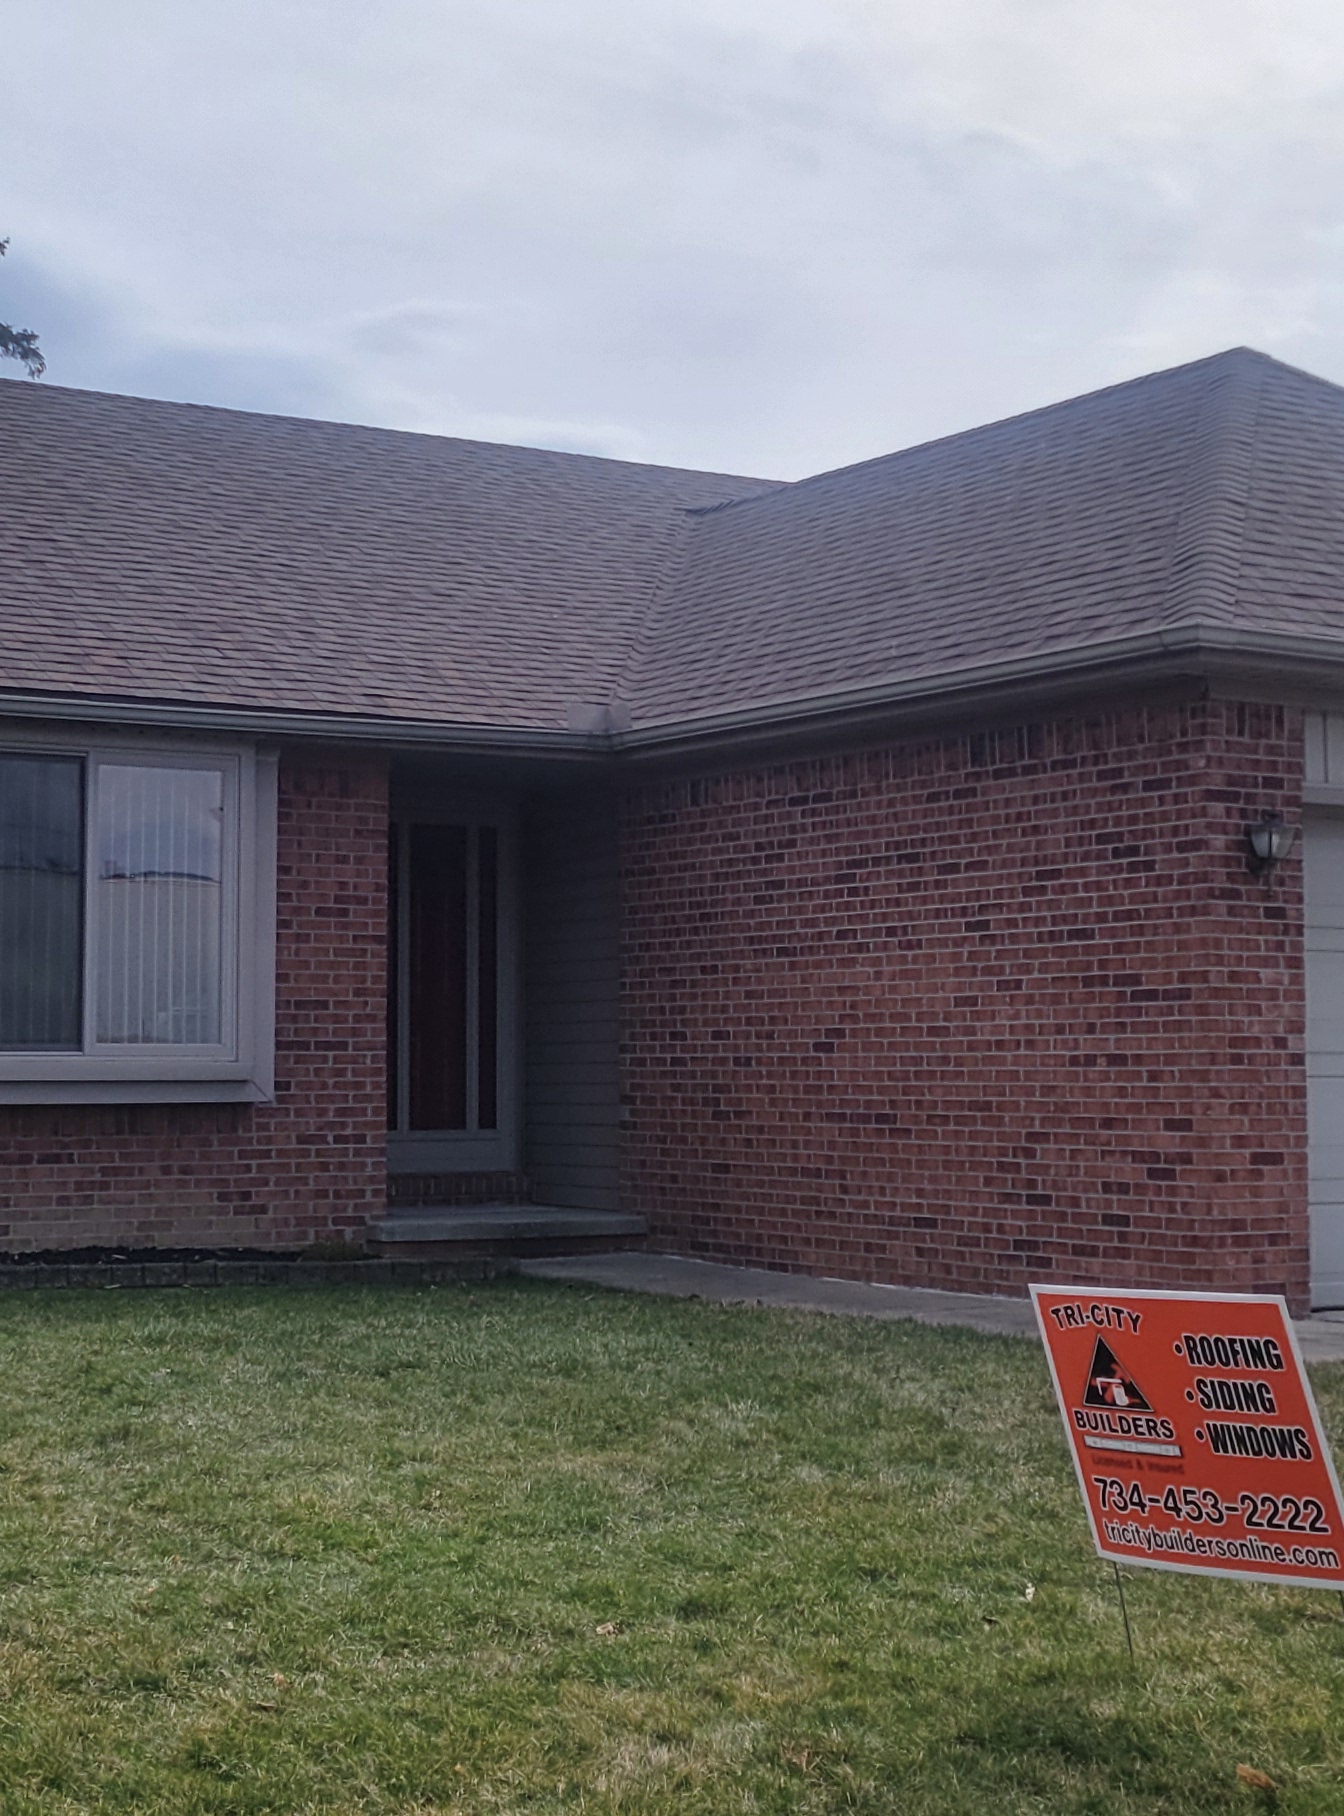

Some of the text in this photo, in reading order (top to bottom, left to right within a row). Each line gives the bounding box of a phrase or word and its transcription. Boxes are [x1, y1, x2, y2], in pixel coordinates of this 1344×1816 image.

[1051, 1304, 1141, 1334] TRI-CITY
[1074, 1410, 1174, 1439] BUILDERS
[1094, 1477, 1329, 1533] 734-453-2222
[1104, 1522, 1340, 1569] tricitybuildersonline.com
